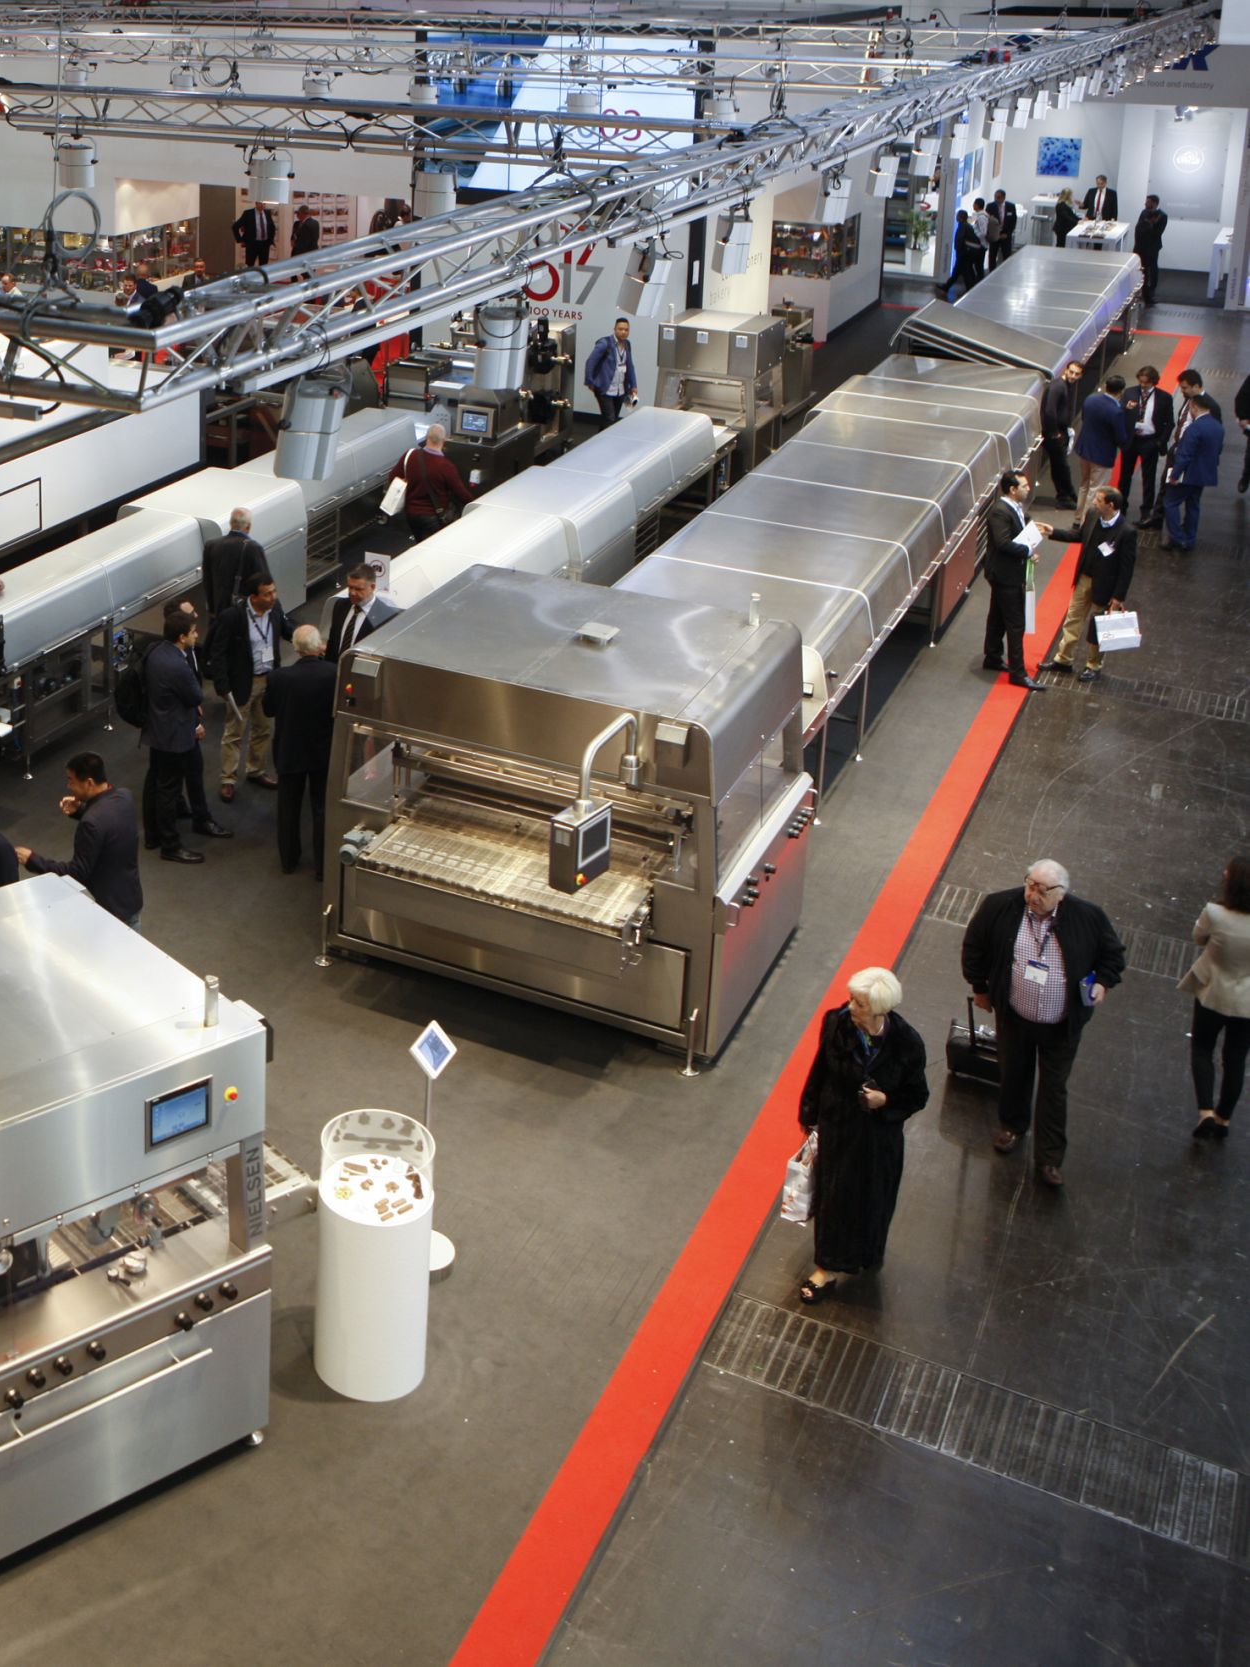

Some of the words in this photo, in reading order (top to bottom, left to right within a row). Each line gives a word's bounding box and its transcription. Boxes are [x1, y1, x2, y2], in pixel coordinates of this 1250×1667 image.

[1147, 79, 1164, 88] food
[1166, 80, 1181, 88] and
[1183, 80, 1214, 90] industry
[521, 260, 605, 305] 017
[552, 308, 583, 320] YEARS
[246, 1147, 264, 1239] NIELSEN
